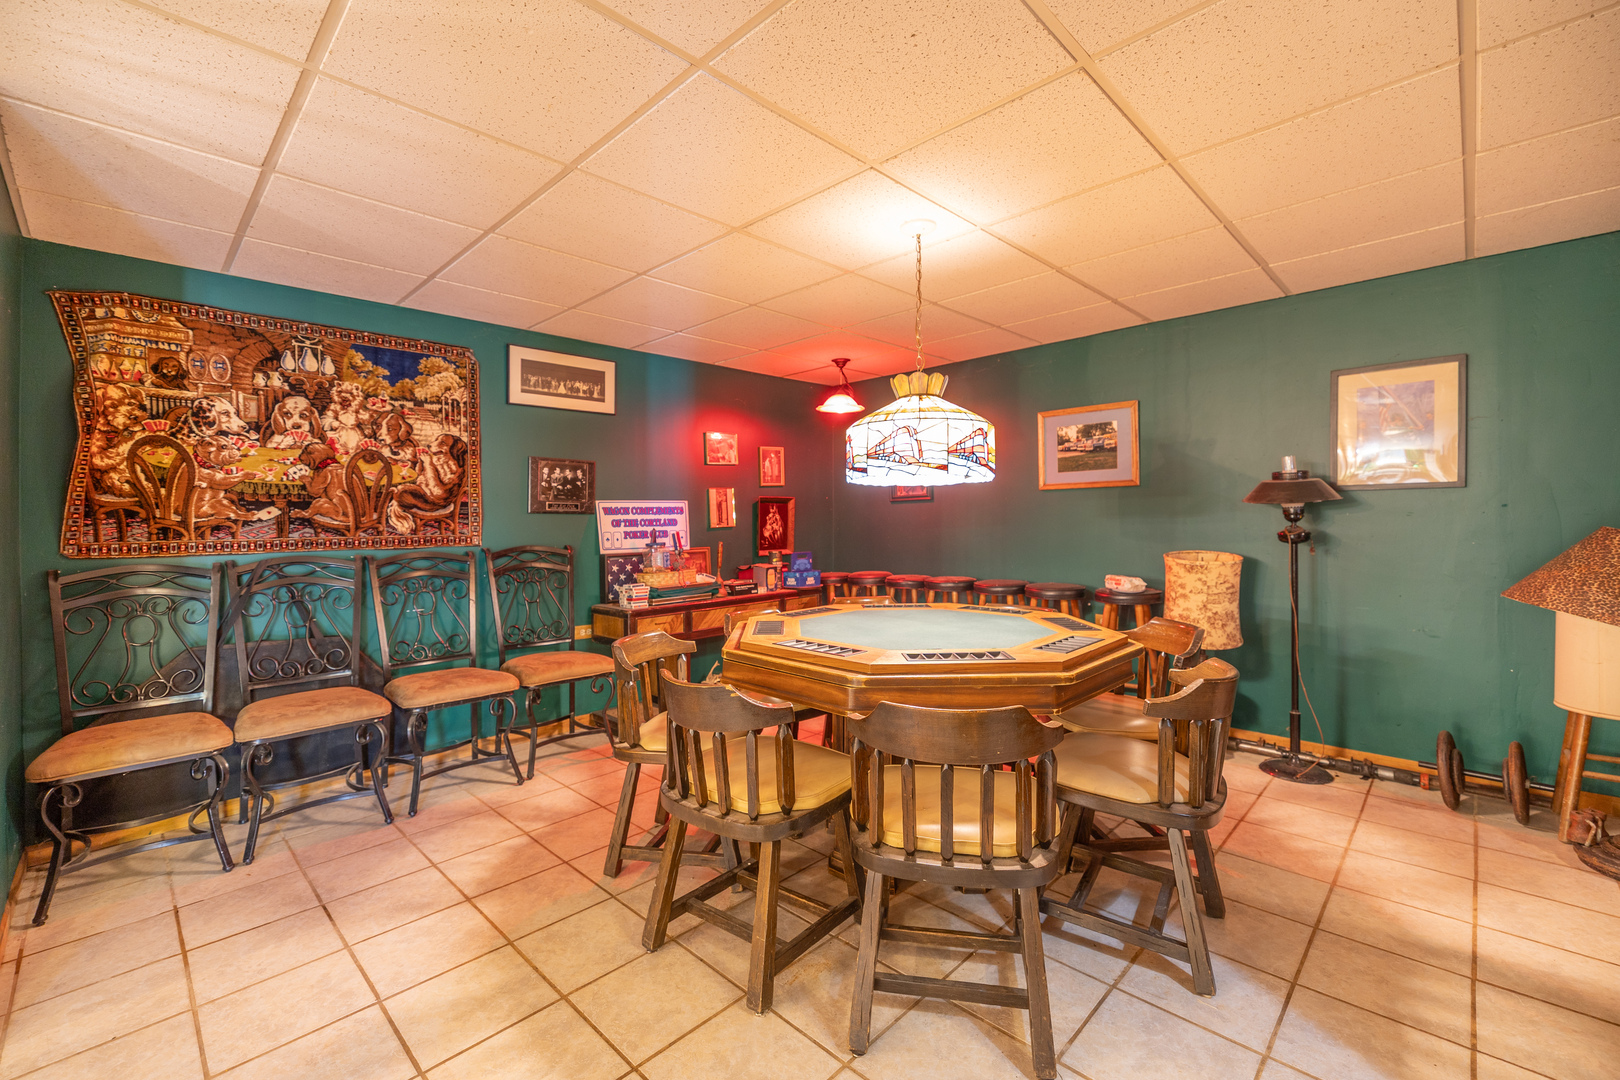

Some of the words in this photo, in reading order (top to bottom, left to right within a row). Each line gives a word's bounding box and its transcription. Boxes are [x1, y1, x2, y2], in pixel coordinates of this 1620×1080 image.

[602, 507, 630, 516] WAGON
[631, 506, 684, 516] COMPLEMENTS
[611, 519, 621, 528] OF
[622, 519, 639, 528] THE
[639, 518, 678, 527] CORTLAND
[623, 530, 649, 540] POKER
